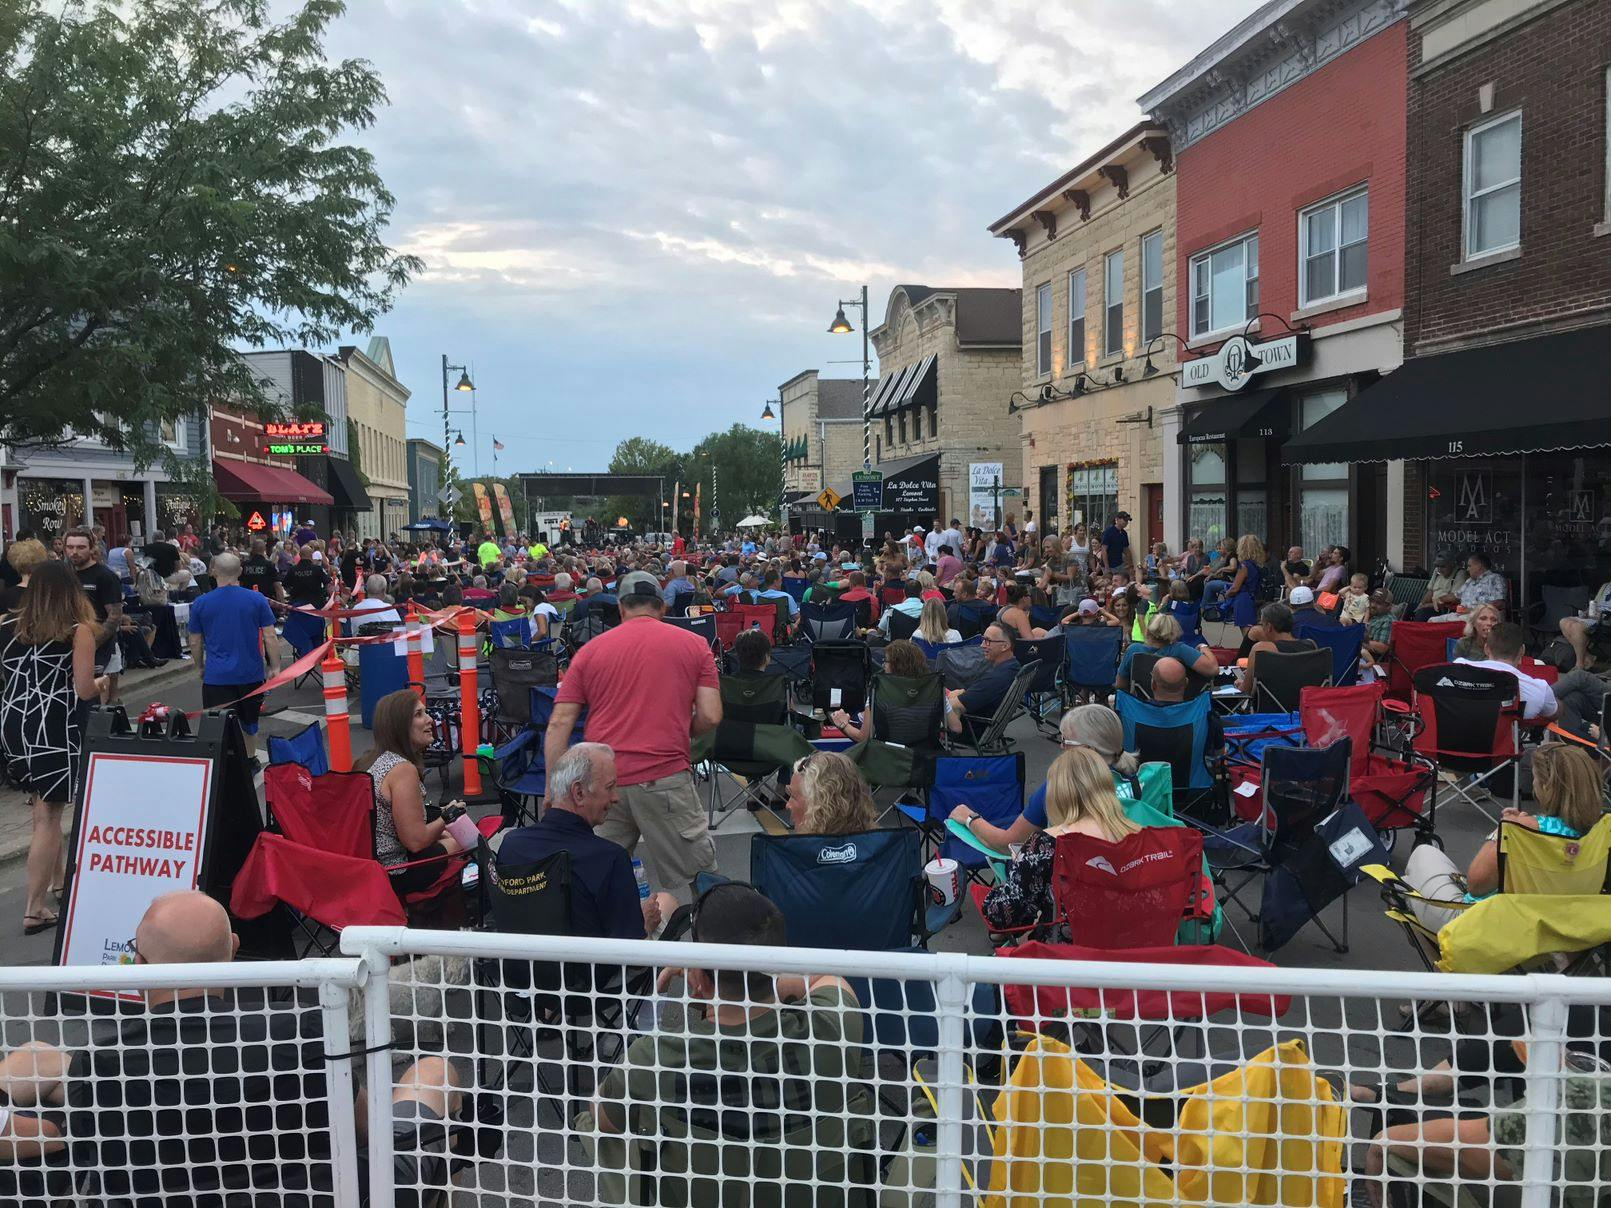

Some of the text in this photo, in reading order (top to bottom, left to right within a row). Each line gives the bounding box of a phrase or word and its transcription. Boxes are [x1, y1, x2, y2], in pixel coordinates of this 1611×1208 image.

[1190, 344, 1293, 380] OLD TOWN
[1259, 428, 1273, 436] 113
[270, 444, 323, 454] TOM'S PLACE
[1448, 440, 1463, 453] 115
[972, 464, 1002, 475] La Dolce
[887, 481, 937, 490] La Dolce Vita
[34, 497, 67, 516] Smokey
[43, 516, 63, 532] Row
[1438, 529, 1512, 544] MODEL ACT
[88, 825, 194, 851] ACCESSIBLE
[821, 846, 854, 860] Coleman
[90, 853, 186, 878] PATHWAY
